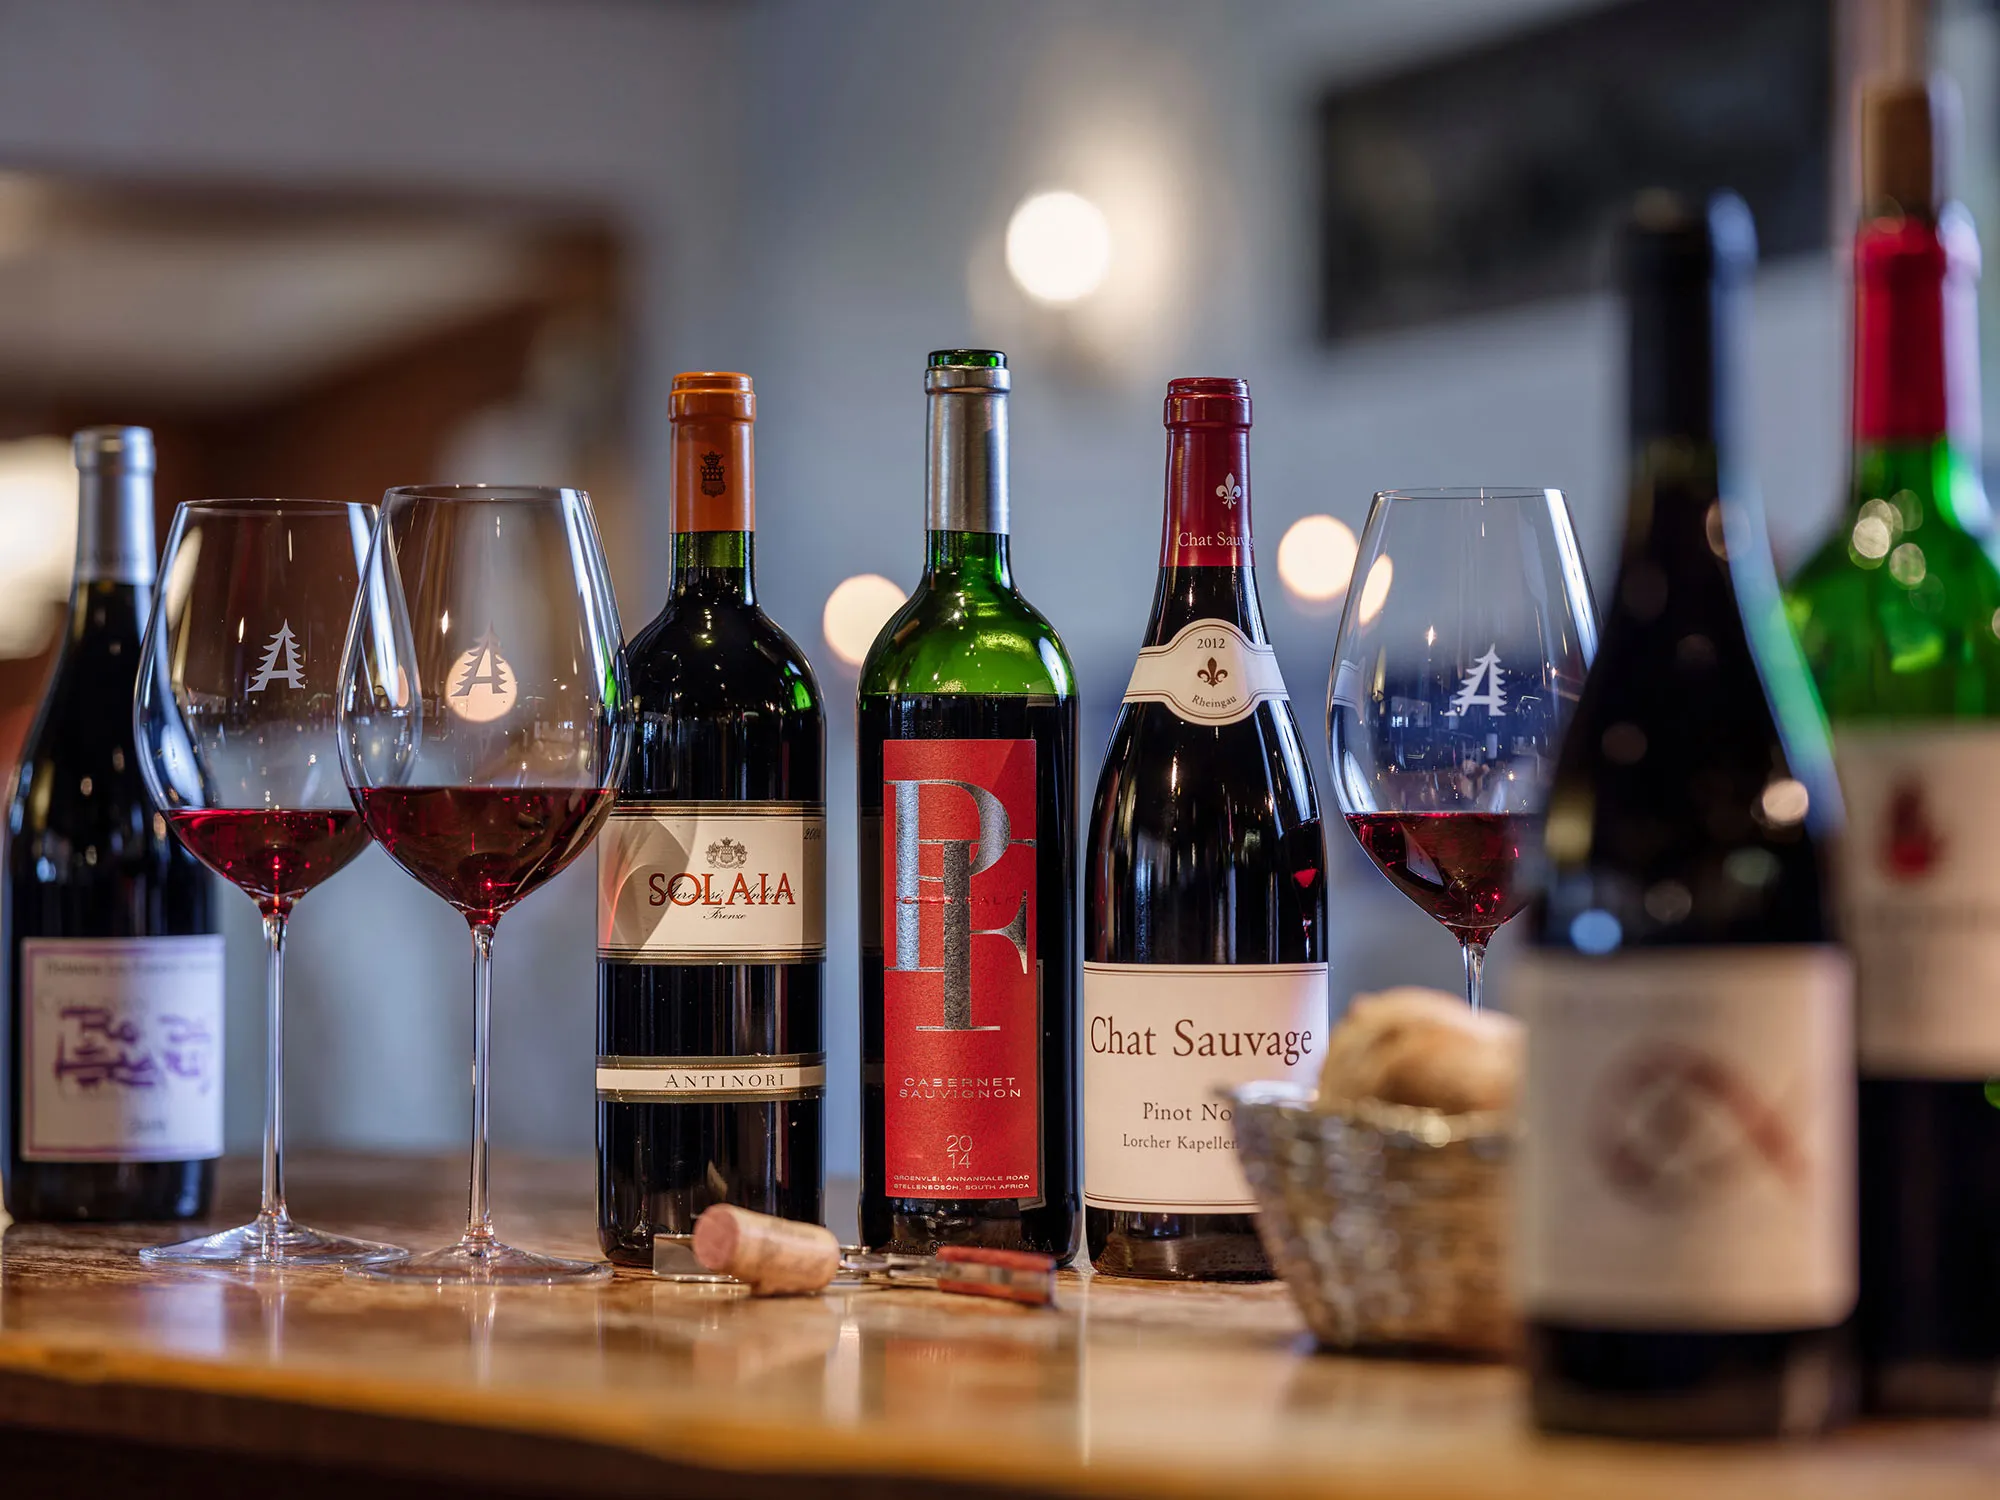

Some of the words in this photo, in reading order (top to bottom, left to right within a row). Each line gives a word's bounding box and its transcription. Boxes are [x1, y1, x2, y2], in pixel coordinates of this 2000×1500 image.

[1178, 532, 1213, 547] Chat
[1197, 638, 1225, 649] 2012
[1191, 694, 1237, 709] Rheingau
[648, 872, 796, 906] SOLAIA
[702, 906, 748, 920] Firenze
[1090, 1015, 1157, 1056] Chat
[1173, 1019, 1313, 1066] Sauvage
[664, 1073, 785, 1089] ANTINORI
[904, 1077, 1016, 1088] CABERNET
[899, 1088, 1022, 1099] SAUVIGNON
[1143, 1102, 1193, 1121] Pinot
[1201, 1103, 1233, 1122] No
[946, 1134, 973, 1152] 20
[1123, 1133, 1171, 1149] Lorcher
[948, 1153, 971, 1169] 14
[999, 1182, 1030, 1190] AFRICA
